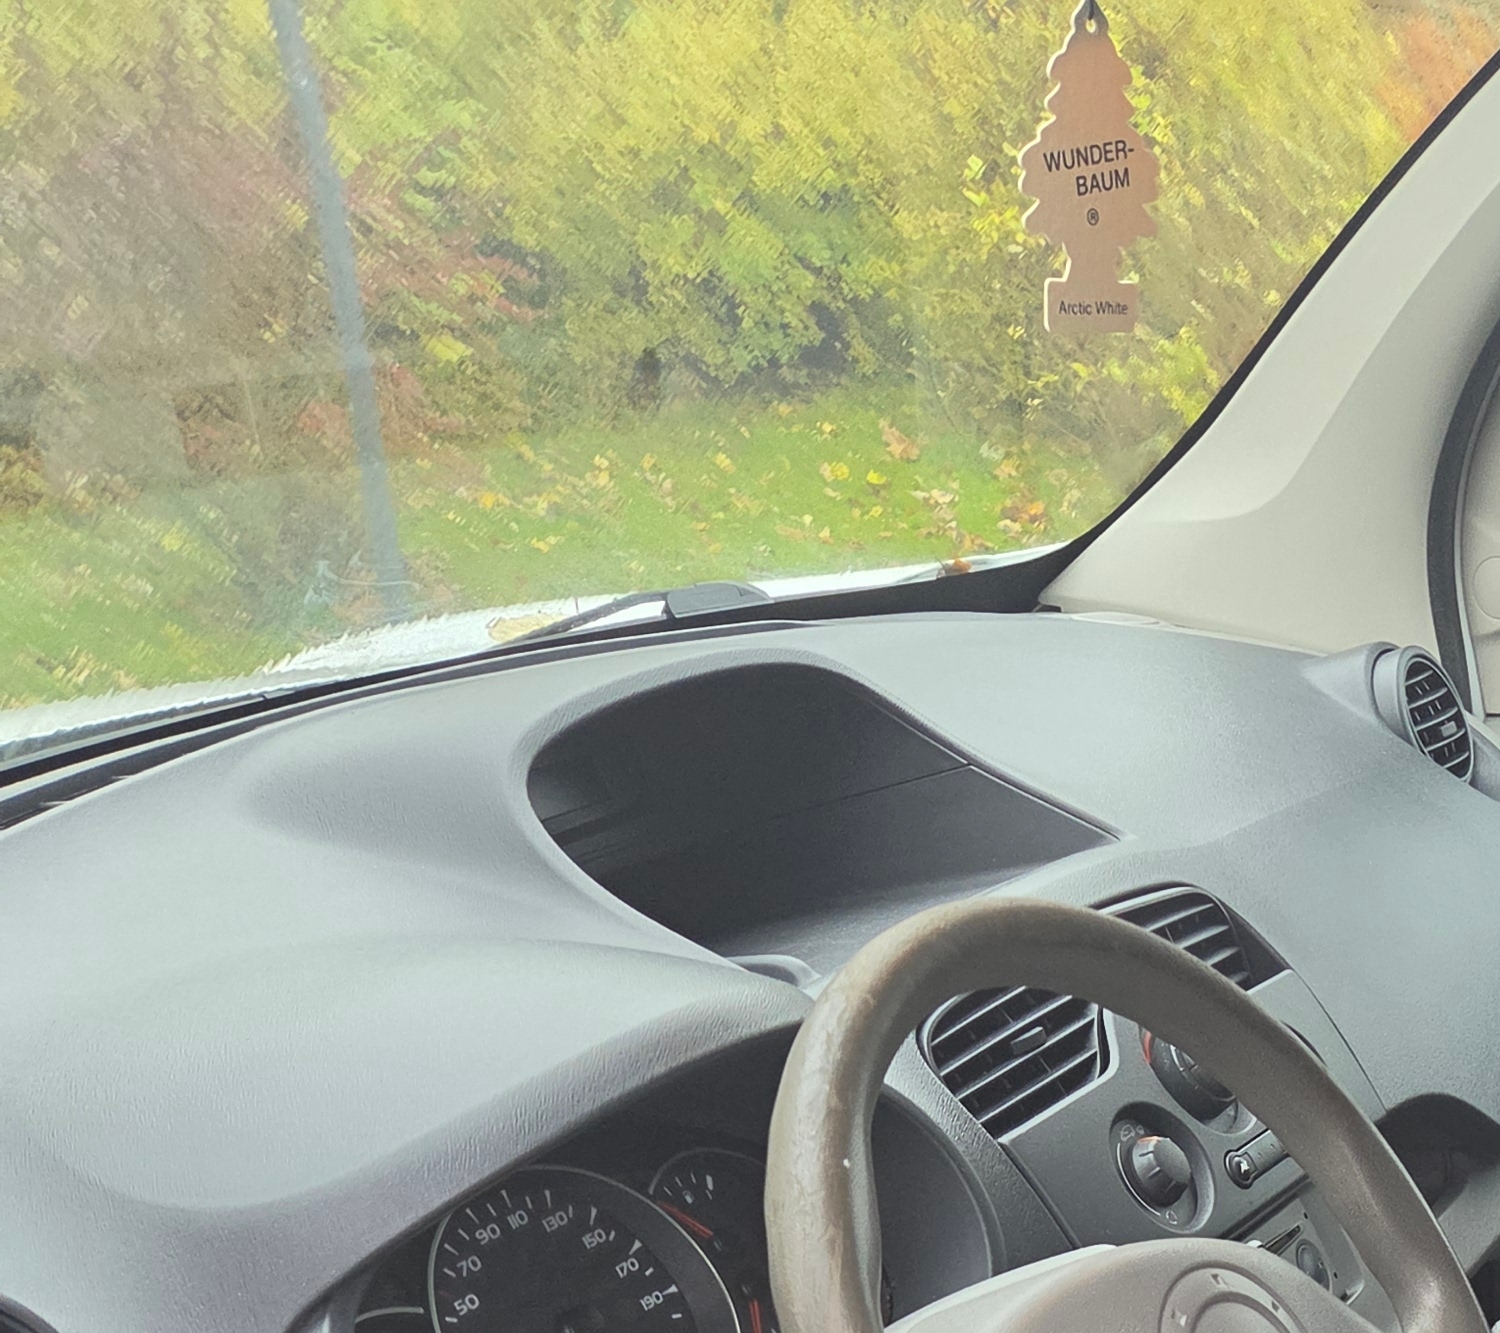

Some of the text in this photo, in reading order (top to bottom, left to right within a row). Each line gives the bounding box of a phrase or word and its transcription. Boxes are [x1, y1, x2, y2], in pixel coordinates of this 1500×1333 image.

[1043, 139, 1135, 173] WUNDER-
[1075, 167, 1130, 197] BAUM
[1058, 300, 1128, 316] Arctic White
[507, 1210, 529, 1230] 110
[542, 1211, 568, 1233] 130
[474, 1223, 501, 1246] 90
[582, 1228, 607, 1250] 150
[456, 1255, 482, 1278] 70
[615, 1257, 640, 1279] 170
[453, 1294, 480, 1316] 50
[639, 1291, 664, 1312] 190
